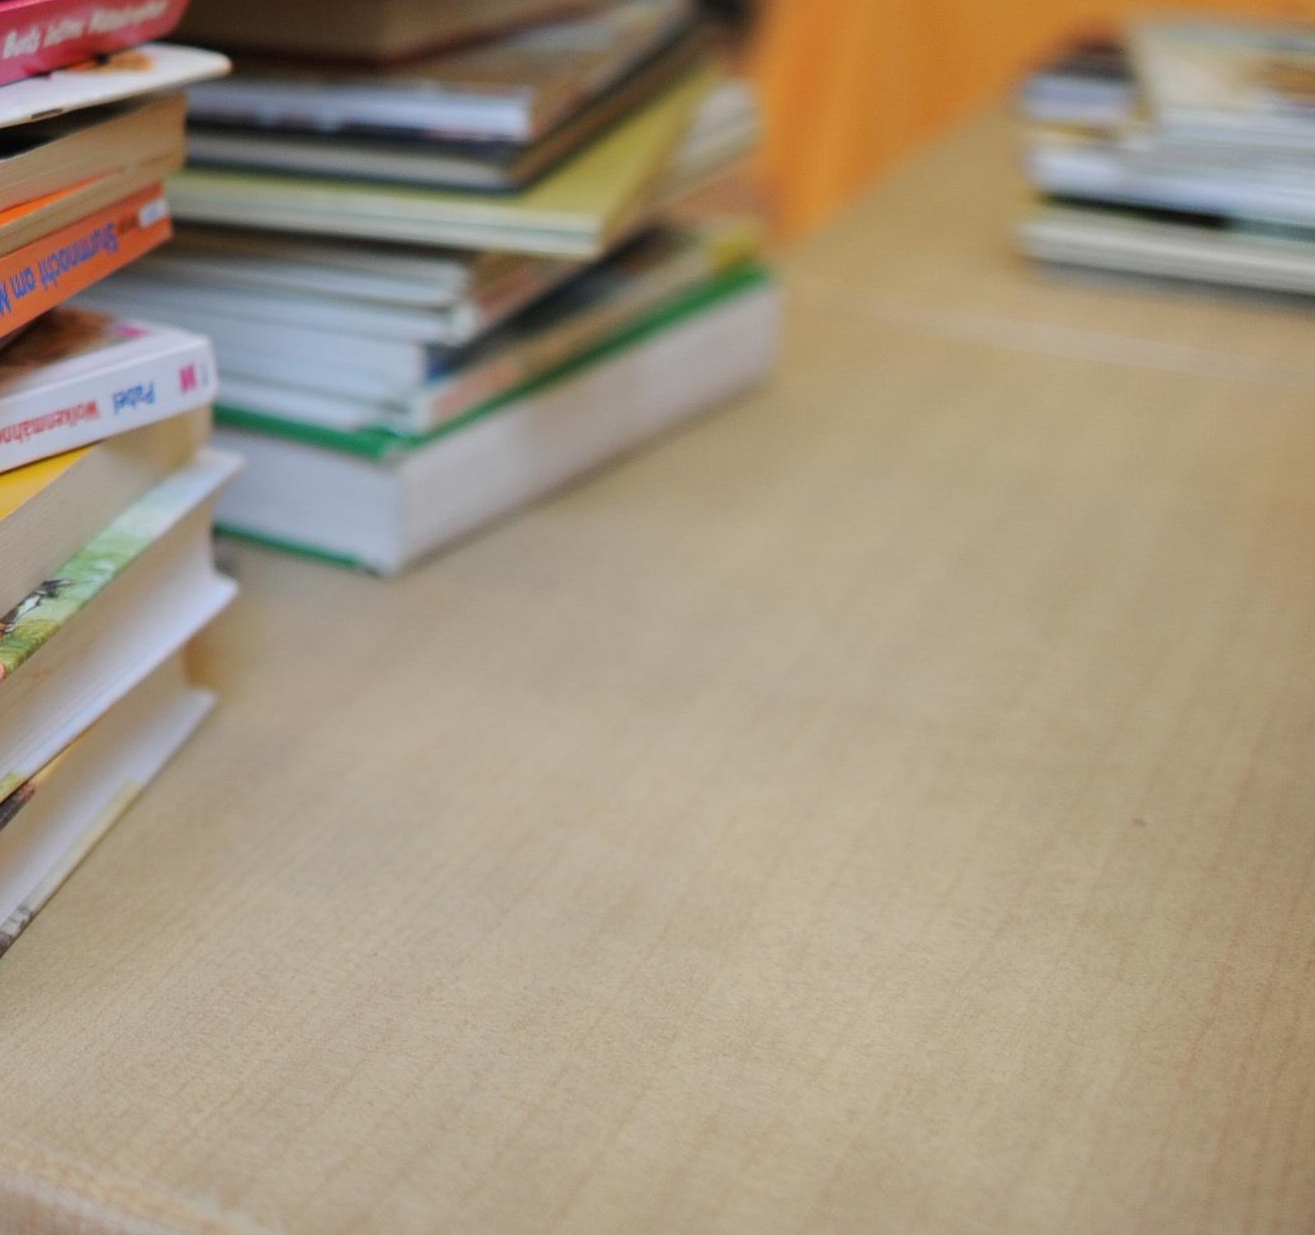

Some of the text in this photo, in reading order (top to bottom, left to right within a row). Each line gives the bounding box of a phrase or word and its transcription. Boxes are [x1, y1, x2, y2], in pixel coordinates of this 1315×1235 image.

[37, 221, 121, 291] Sturmnacht
[9, 267, 35, 298] am
[112, 380, 157, 417] Pabel
